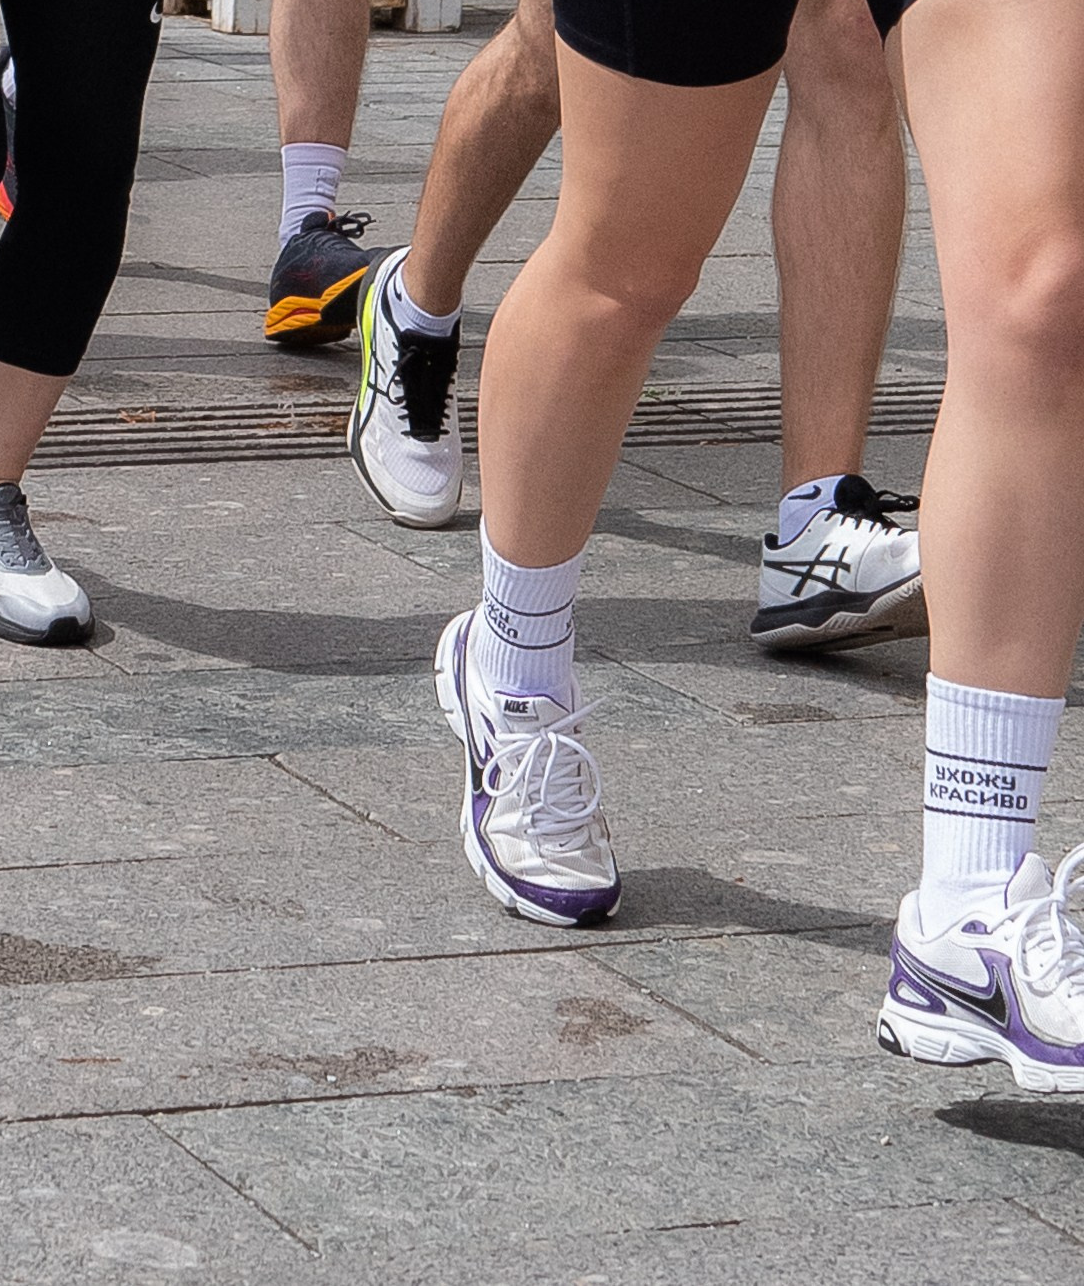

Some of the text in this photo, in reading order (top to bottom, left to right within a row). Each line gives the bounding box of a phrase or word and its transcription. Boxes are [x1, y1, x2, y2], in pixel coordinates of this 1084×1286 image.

[504, 698, 529, 714] NIKE
[936, 764, 1016, 791] УХОЖУ
[930, 781, 1028, 809] КРАСИВО
